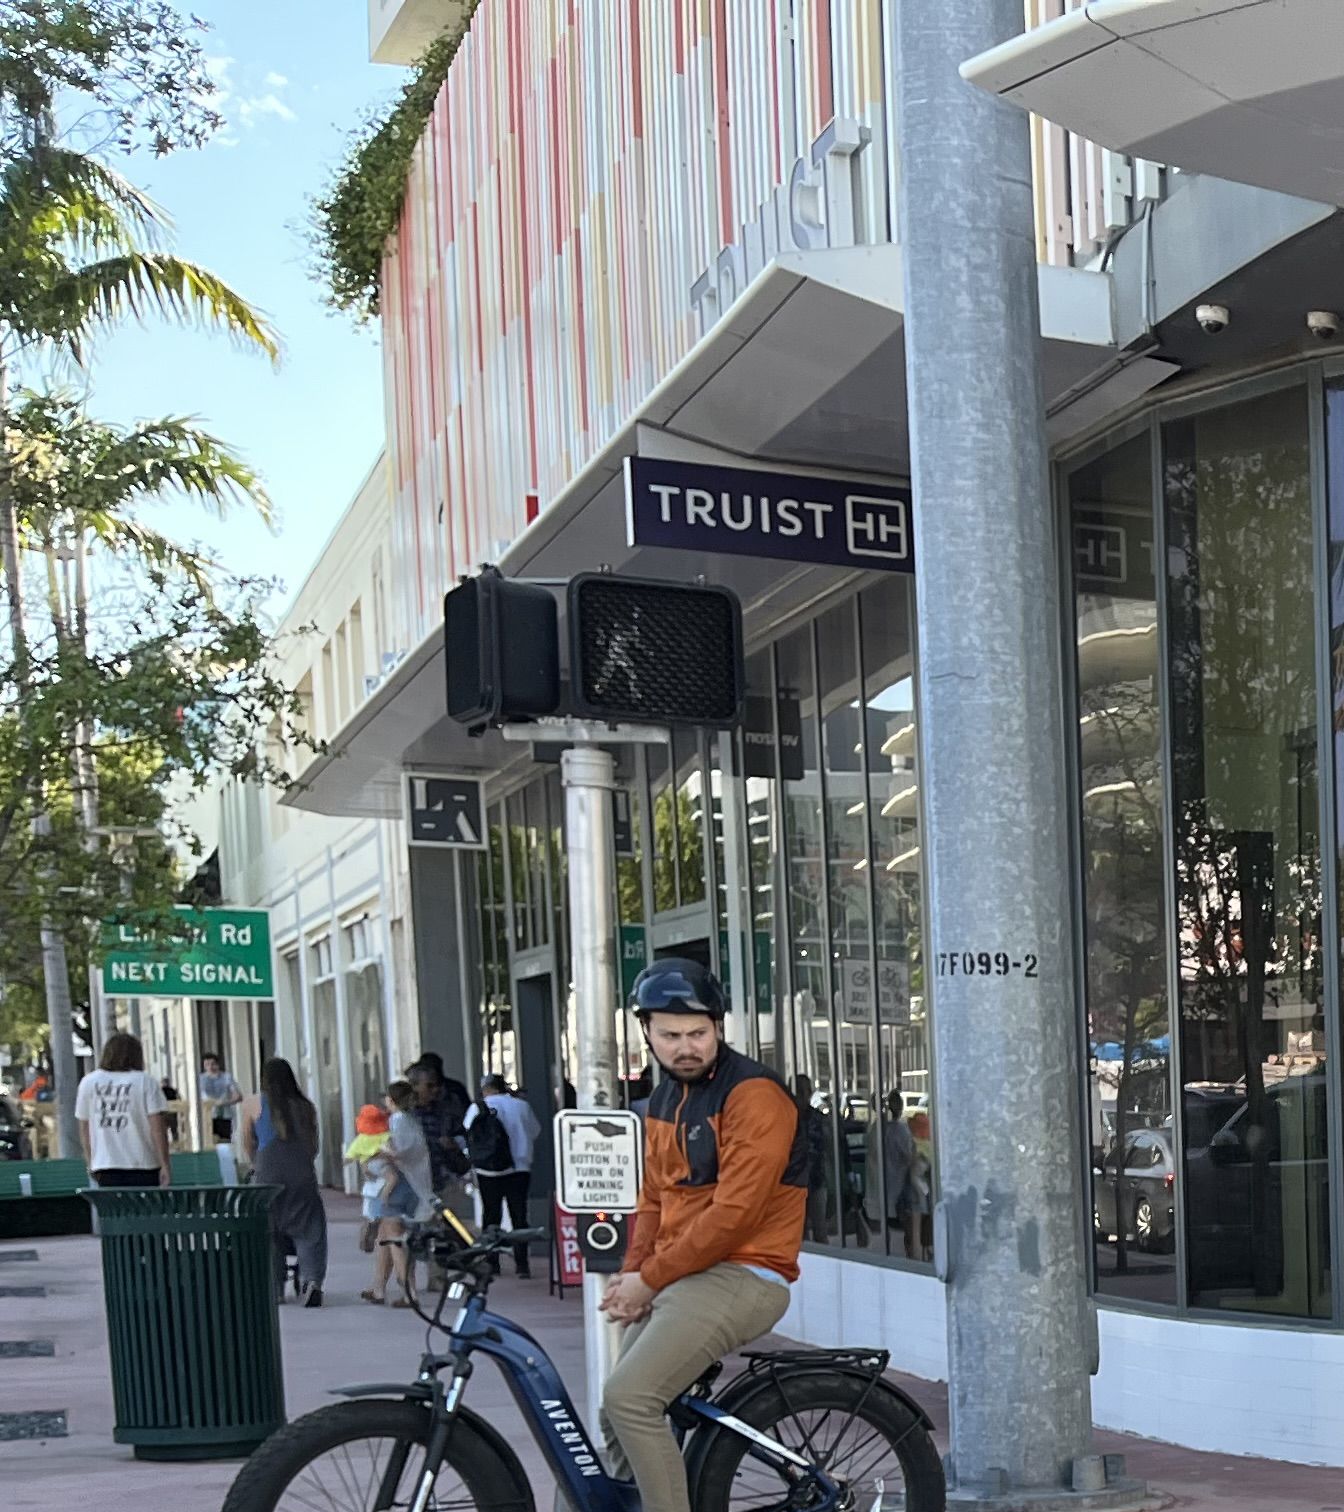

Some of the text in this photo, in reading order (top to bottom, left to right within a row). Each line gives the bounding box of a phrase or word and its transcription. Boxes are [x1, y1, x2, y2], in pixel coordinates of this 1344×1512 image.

[649, 484, 833, 538] TRUIST
[220, 923, 252, 945] Rd
[111, 962, 264, 984] NEXT SIGNAL
[584, 1141, 614, 1151] PUSH
[616, 1155, 629, 1165] TO
[576, 1167, 624, 1177] TURN ON
[577, 1180, 623, 1190] WARNING
[583, 1193, 619, 1203] LIGHTS
[540, 1399, 601, 1478] AVENTON
